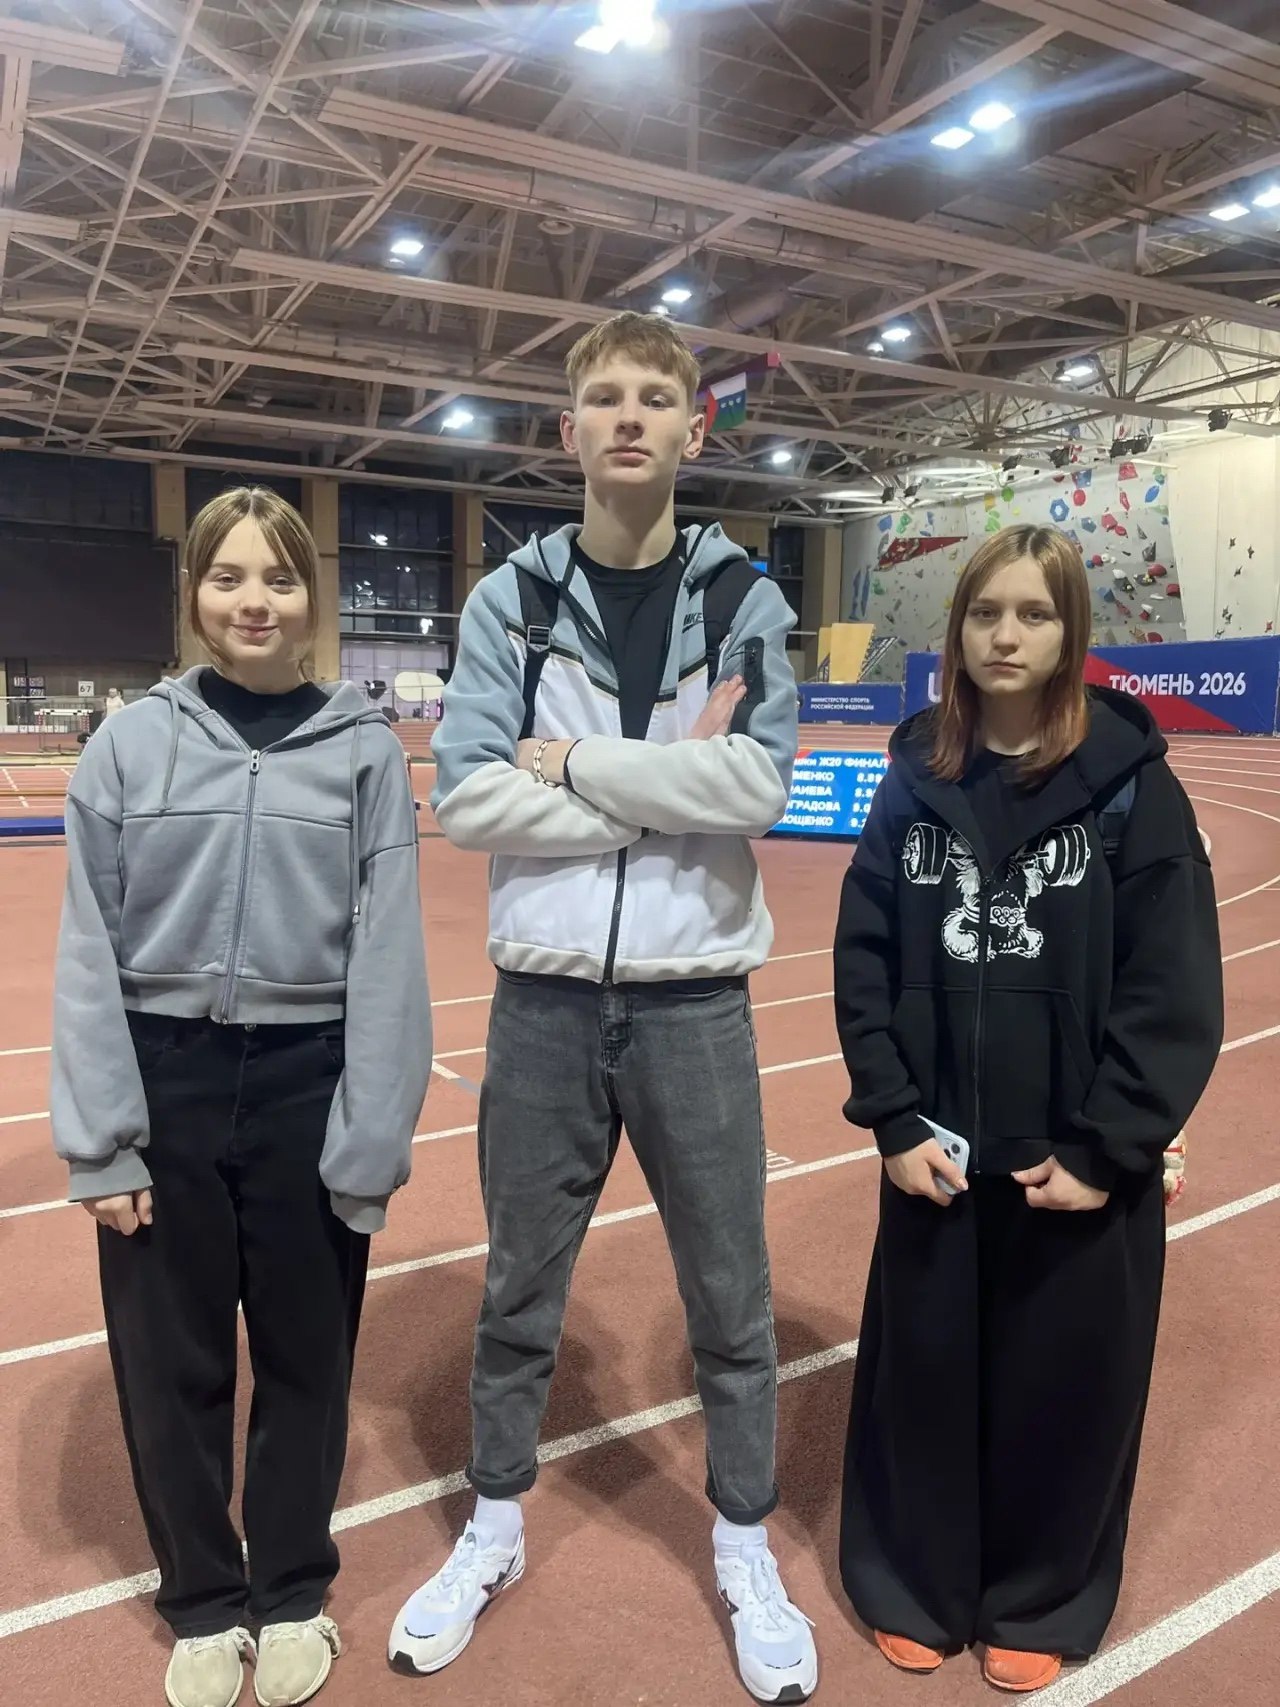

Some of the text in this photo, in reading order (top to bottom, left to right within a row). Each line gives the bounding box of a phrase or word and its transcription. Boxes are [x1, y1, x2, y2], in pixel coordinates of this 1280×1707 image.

[684, 613, 702, 626] NIKE
[1109, 672, 1246, 696] ТЮМЕНЬ 2026
[844, 758, 888, 768] ФИНАЛ
